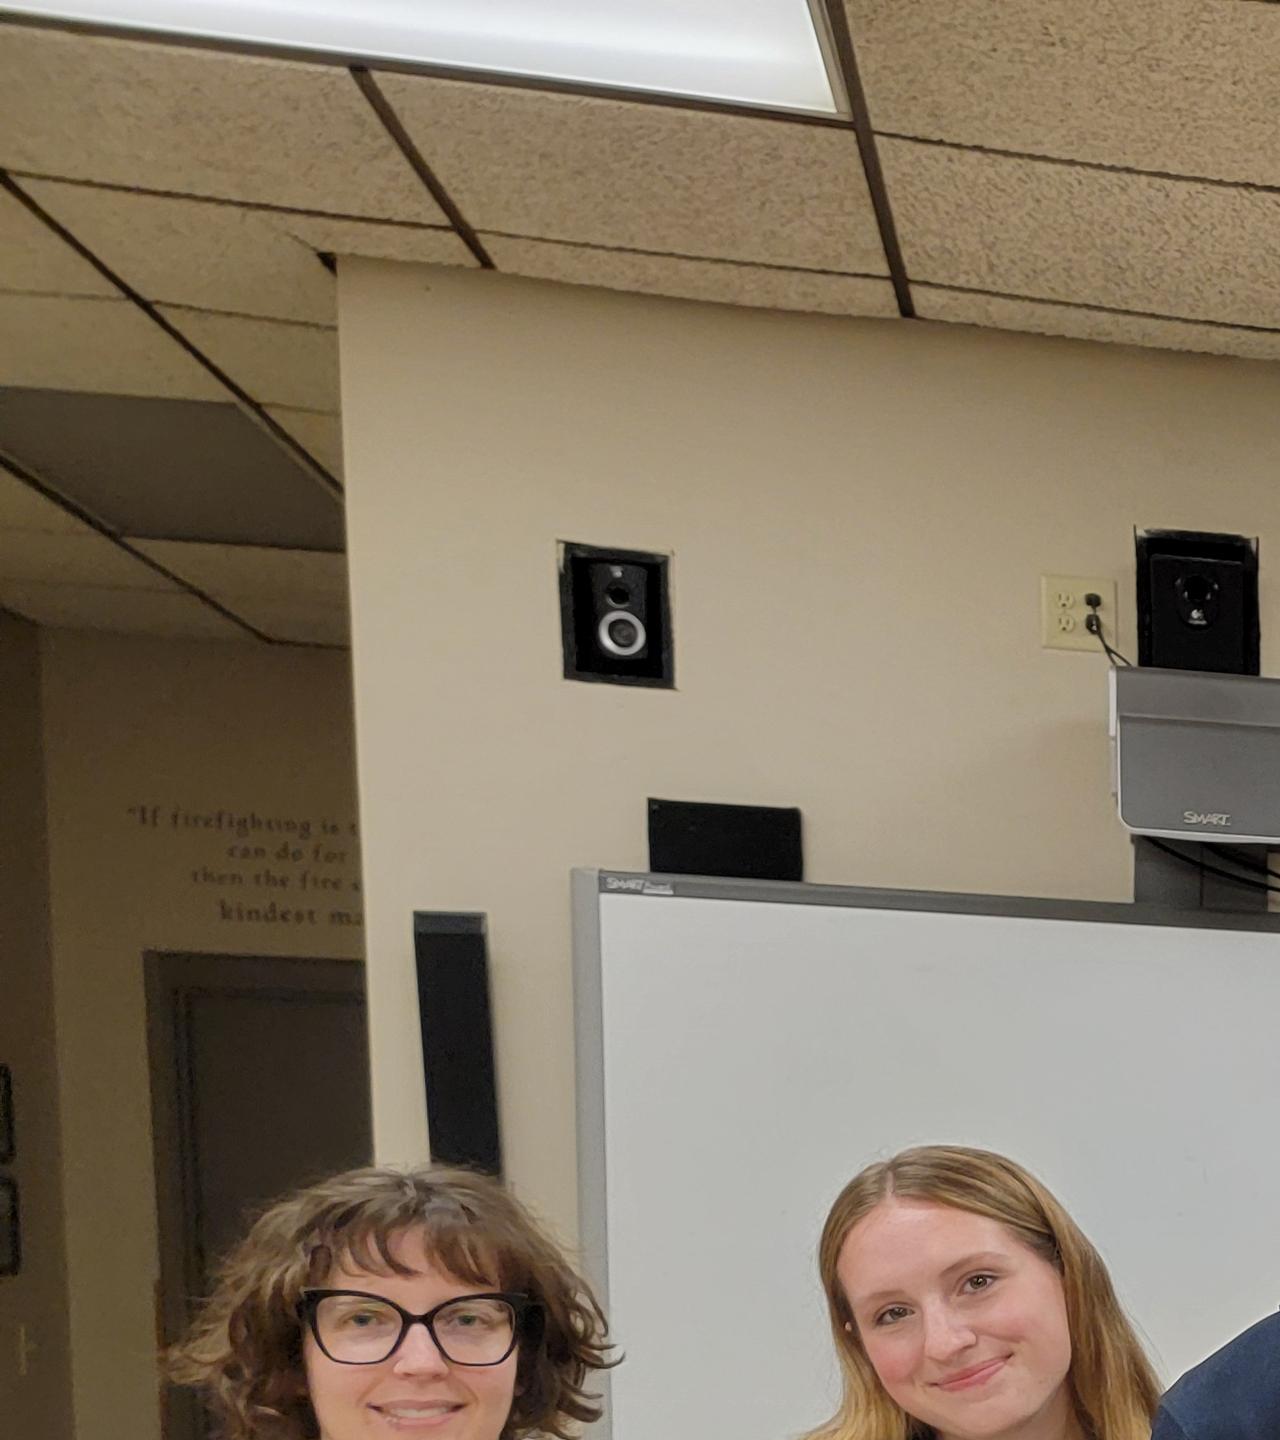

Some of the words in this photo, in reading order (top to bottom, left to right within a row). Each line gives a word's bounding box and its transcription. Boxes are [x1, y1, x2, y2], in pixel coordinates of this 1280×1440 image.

[171, 808, 311, 839] firefighting
[1182, 811, 1232, 826] SMART
[254, 868, 289, 890] the
[218, 898, 316, 926] kindest
